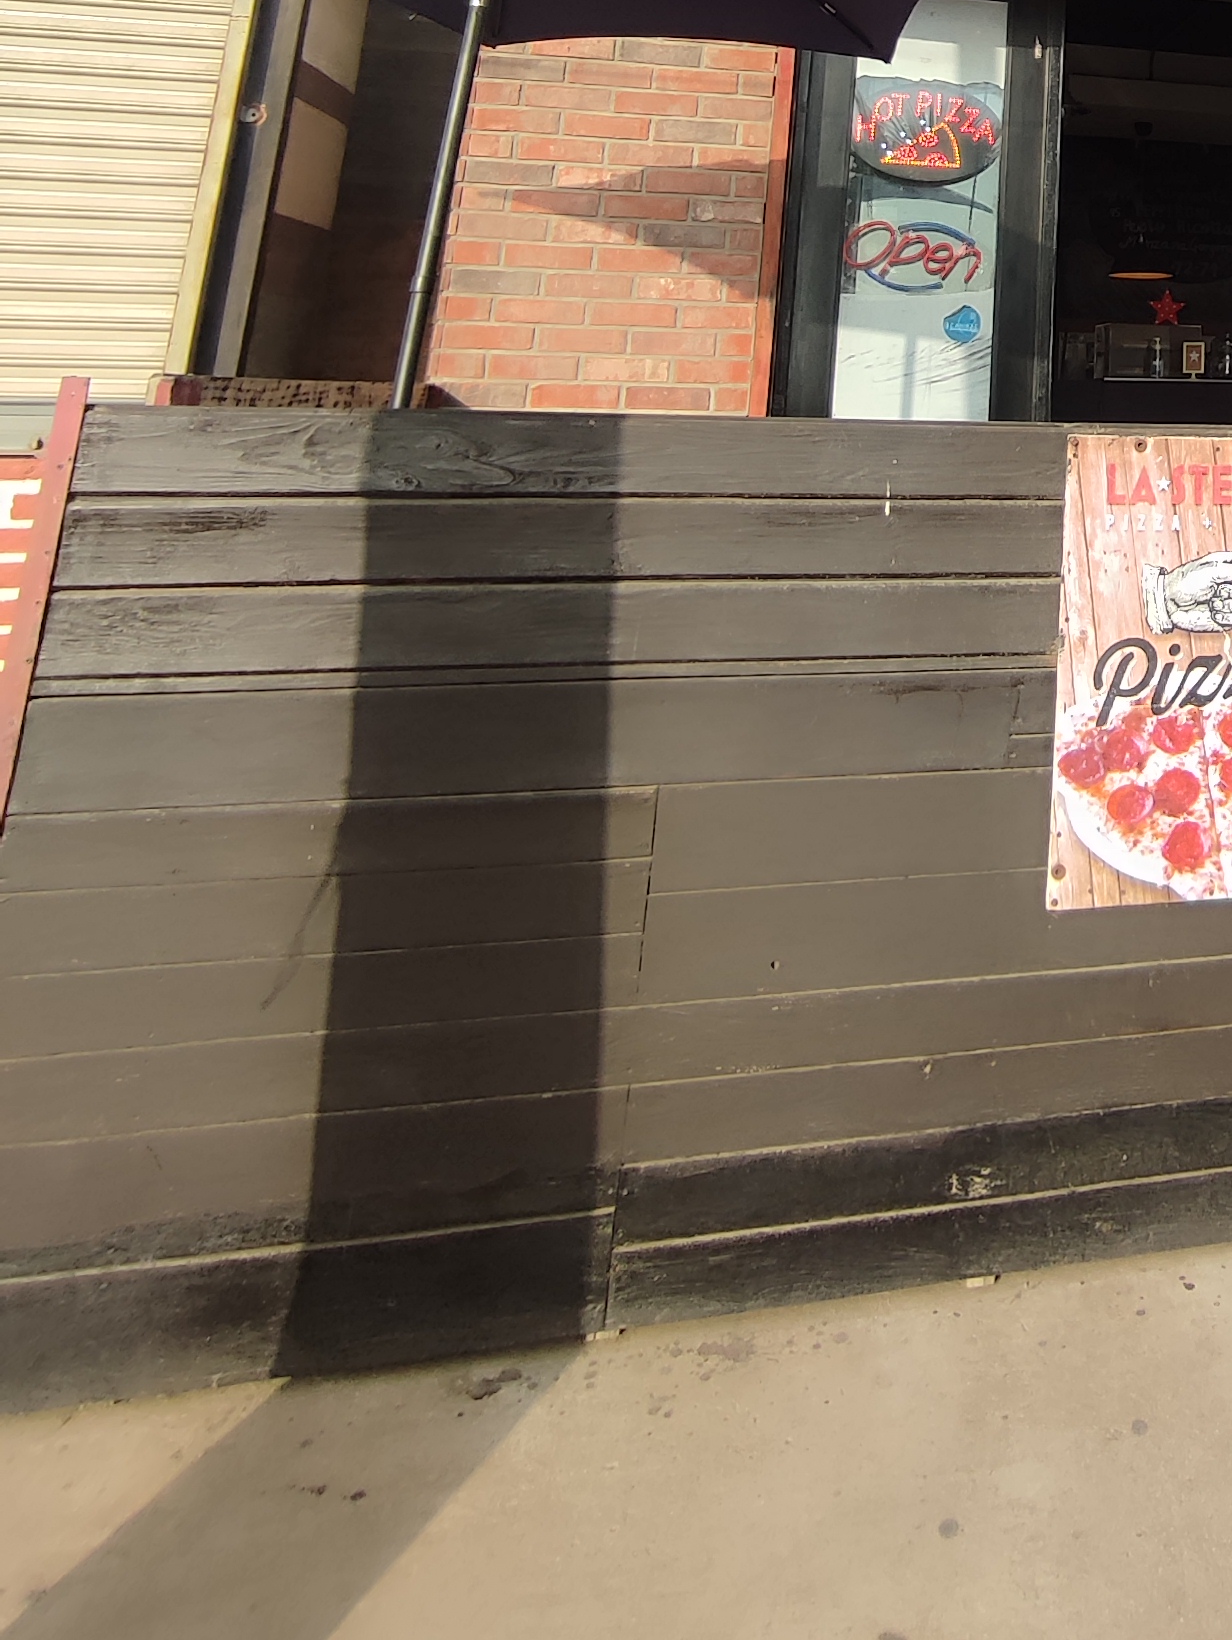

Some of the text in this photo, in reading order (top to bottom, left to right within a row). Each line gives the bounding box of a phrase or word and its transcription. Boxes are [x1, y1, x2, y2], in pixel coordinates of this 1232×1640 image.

[854, 89, 996, 146] HOT PIZZA
[843, 218, 983, 283] Open
[1106, 463, 1157, 506] LA
[1105, 513, 1182, 532] PIZZA
